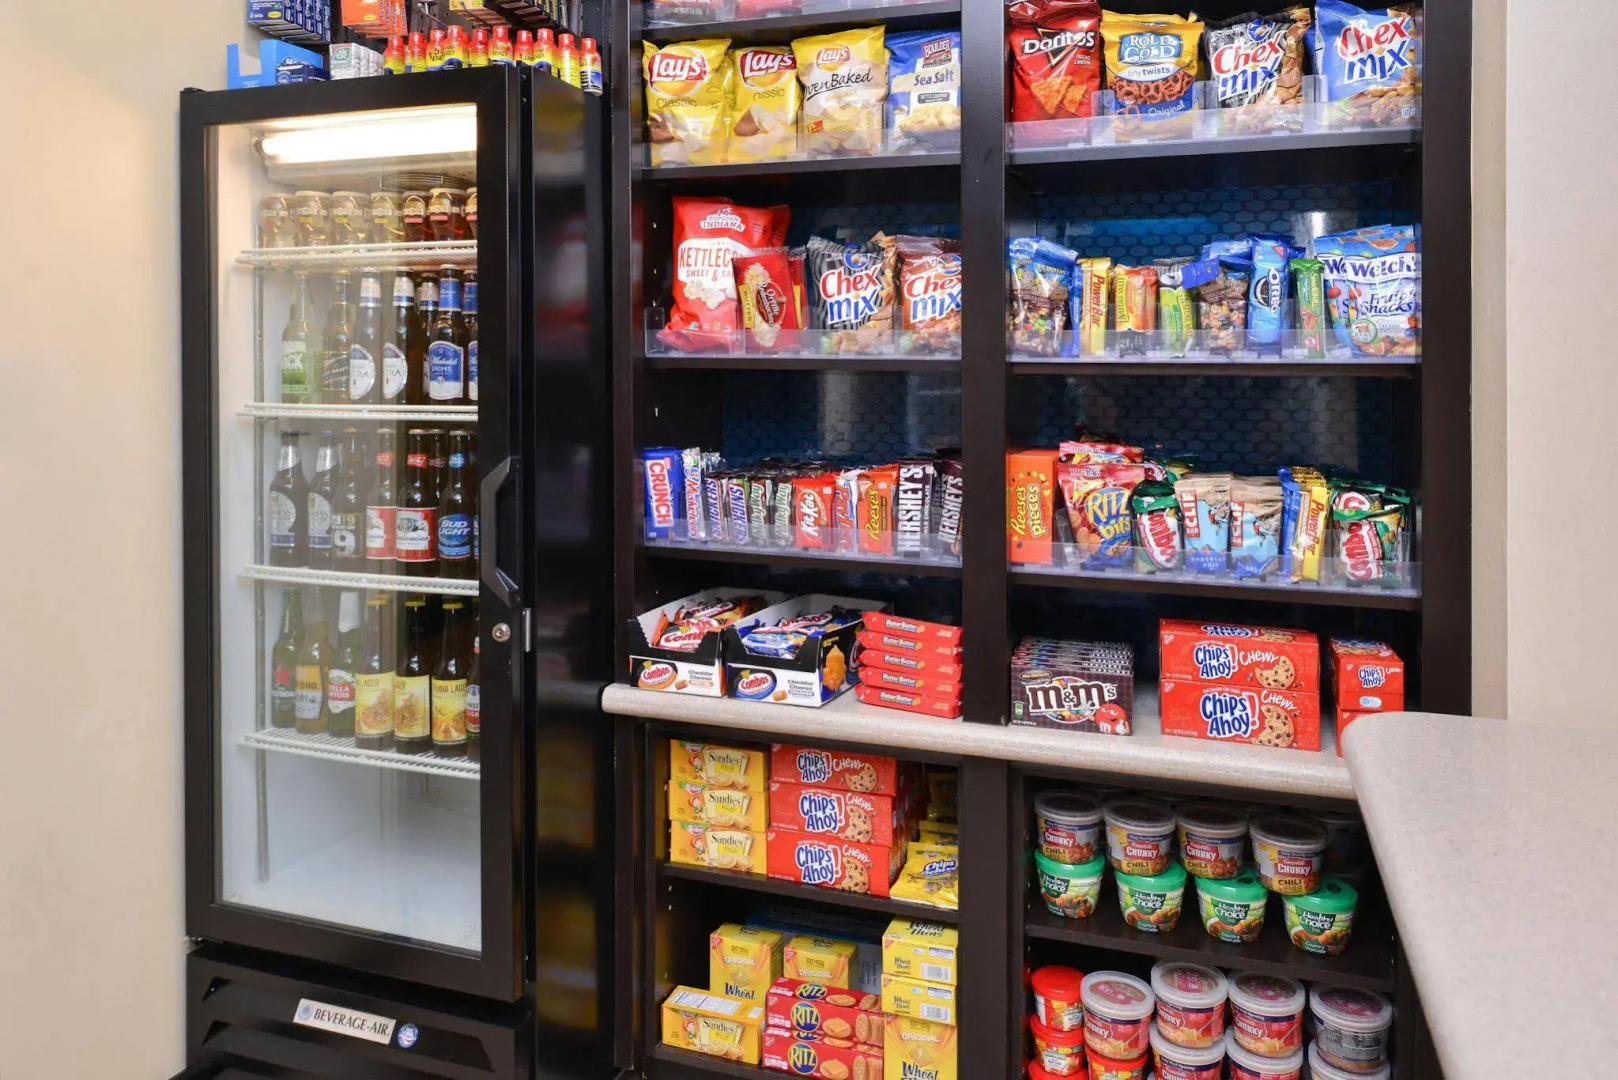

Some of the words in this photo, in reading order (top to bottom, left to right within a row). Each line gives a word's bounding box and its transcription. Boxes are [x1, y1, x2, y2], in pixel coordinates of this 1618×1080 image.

[1024, 30, 1096, 54] Doritos
[1130, 35, 1176, 47] ROLD
[1340, 18, 1408, 58] Chex
[1214, 32, 1283, 74] Chex
[1347, 42, 1411, 82] mix
[652, 54, 702, 82] Lay's
[744, 51, 794, 77] Lay's
[1142, 66, 1170, 76] twists
[831, 68, 873, 87] Baked
[914, 74, 932, 86] Sea
[934, 70, 954, 83] Salt
[1220, 56, 1279, 98] mix
[1148, 101, 1184, 116] Original
[702, 221, 742, 231] INDIANA
[686, 270, 709, 278] SWEET
[712, 270, 718, 281] &
[822, 265, 879, 298] Chex
[1268, 268, 1281, 313] OREO
[829, 289, 876, 323] mix
[1360, 300, 1412, 316] Snacks
[649, 462, 671, 525] CRUNCH
[898, 464, 923, 551] HERSHEY'S
[1027, 484, 1048, 538] pieces
[1089, 490, 1131, 522] RITZ
[1182, 493, 1198, 526] CLIF
[1195, 646, 1229, 664] Chips
[643, 666, 670, 681] Combos
[1360, 668, 1379, 680] Chips
[741, 676, 769, 690] Combos
[1202, 693, 1247, 720] Chips
[1100, 722, 1110, 733] m
[708, 752, 740, 764] Sandies
[798, 752, 825, 770] Chips
[709, 794, 740, 806] Sandies
[800, 794, 835, 816] Chips
[712, 834, 743, 846] Sandies
[1045, 833, 1073, 847] CHUNKY
[796, 846, 832, 867] Chips
[1127, 848, 1158, 858] CHUNKY
[1187, 846, 1216, 860] CHUNKY
[1278, 864, 1310, 876] CHUNKY
[725, 982, 755, 1000] Wheat
[800, 986, 822, 998] RITZ
[793, 1006, 818, 1027] RITZ
[703, 1020, 734, 1034] Sandies
[790, 1048, 816, 1068] RITZ
[902, 1061, 939, 1080] Wheat
